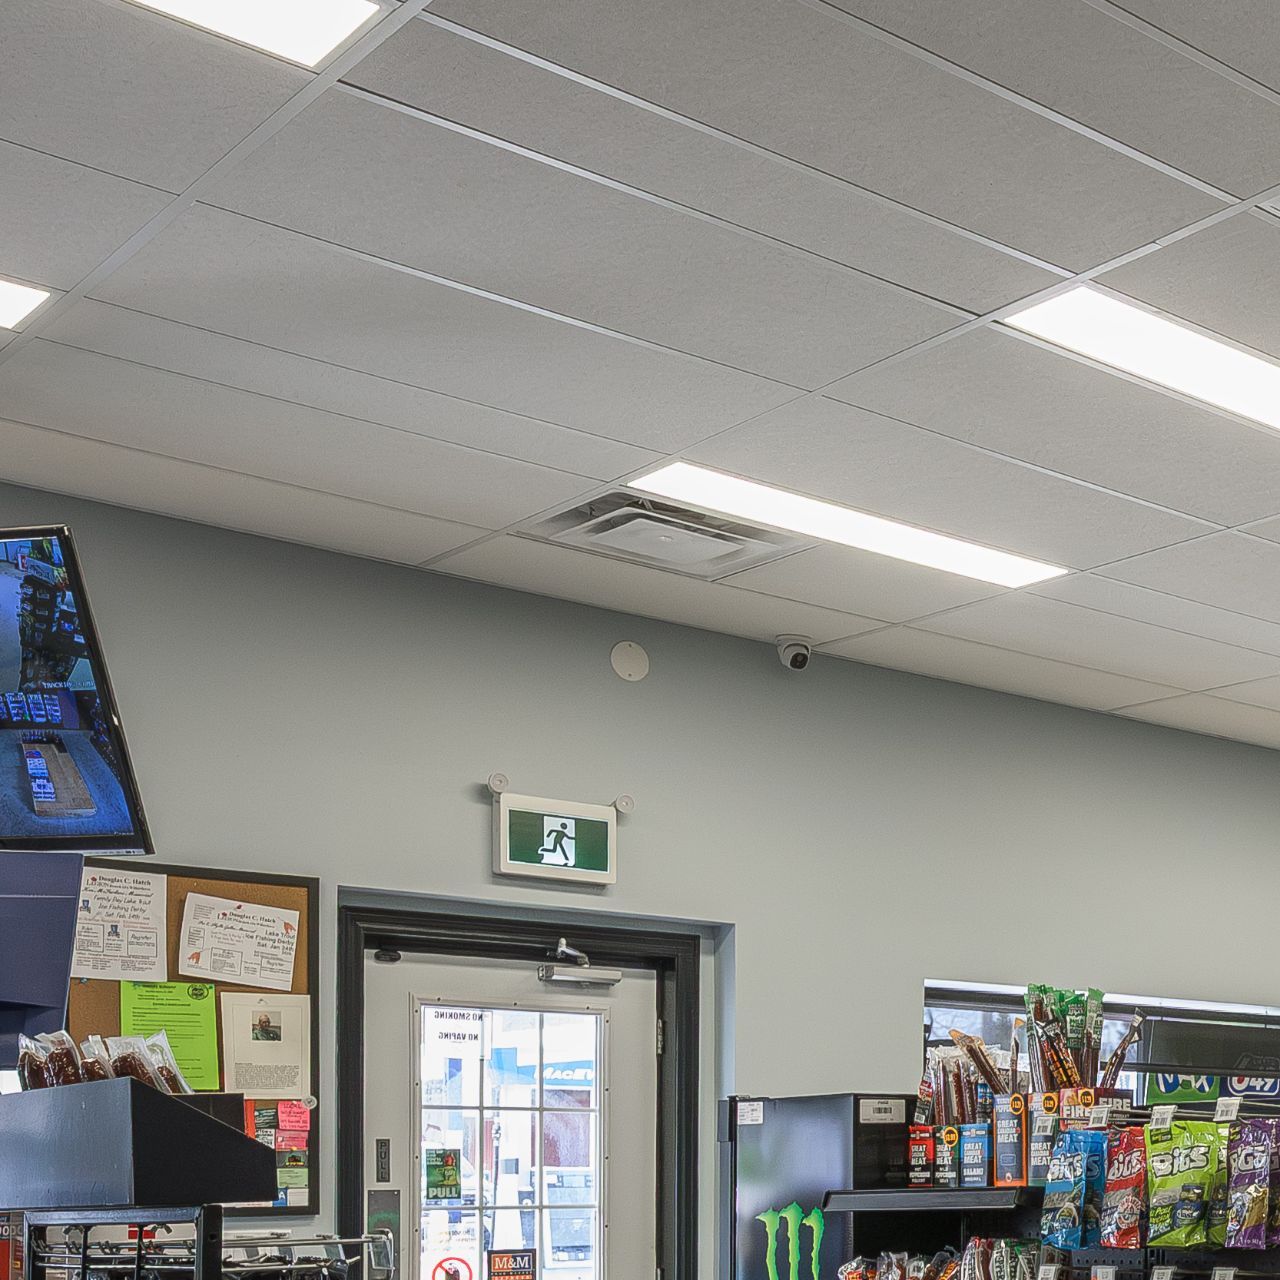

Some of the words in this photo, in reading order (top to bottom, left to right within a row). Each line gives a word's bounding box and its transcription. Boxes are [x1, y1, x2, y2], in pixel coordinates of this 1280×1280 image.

[1100, 1098, 1131, 1111] FIRE
[997, 1120, 1018, 1128] GREAT
[997, 1134, 1018, 1143] MEAT
[964, 1143, 982, 1151] GREAT
[1031, 1143, 1051, 1151] GREAT
[379, 1141, 387, 1180] PULL
[963, 1156, 982, 1164] MEAT
[1031, 1157, 1051, 1165] MEAT
[428, 1187, 458, 1199] PULL
[494, 1256, 531, 1270] M&M
